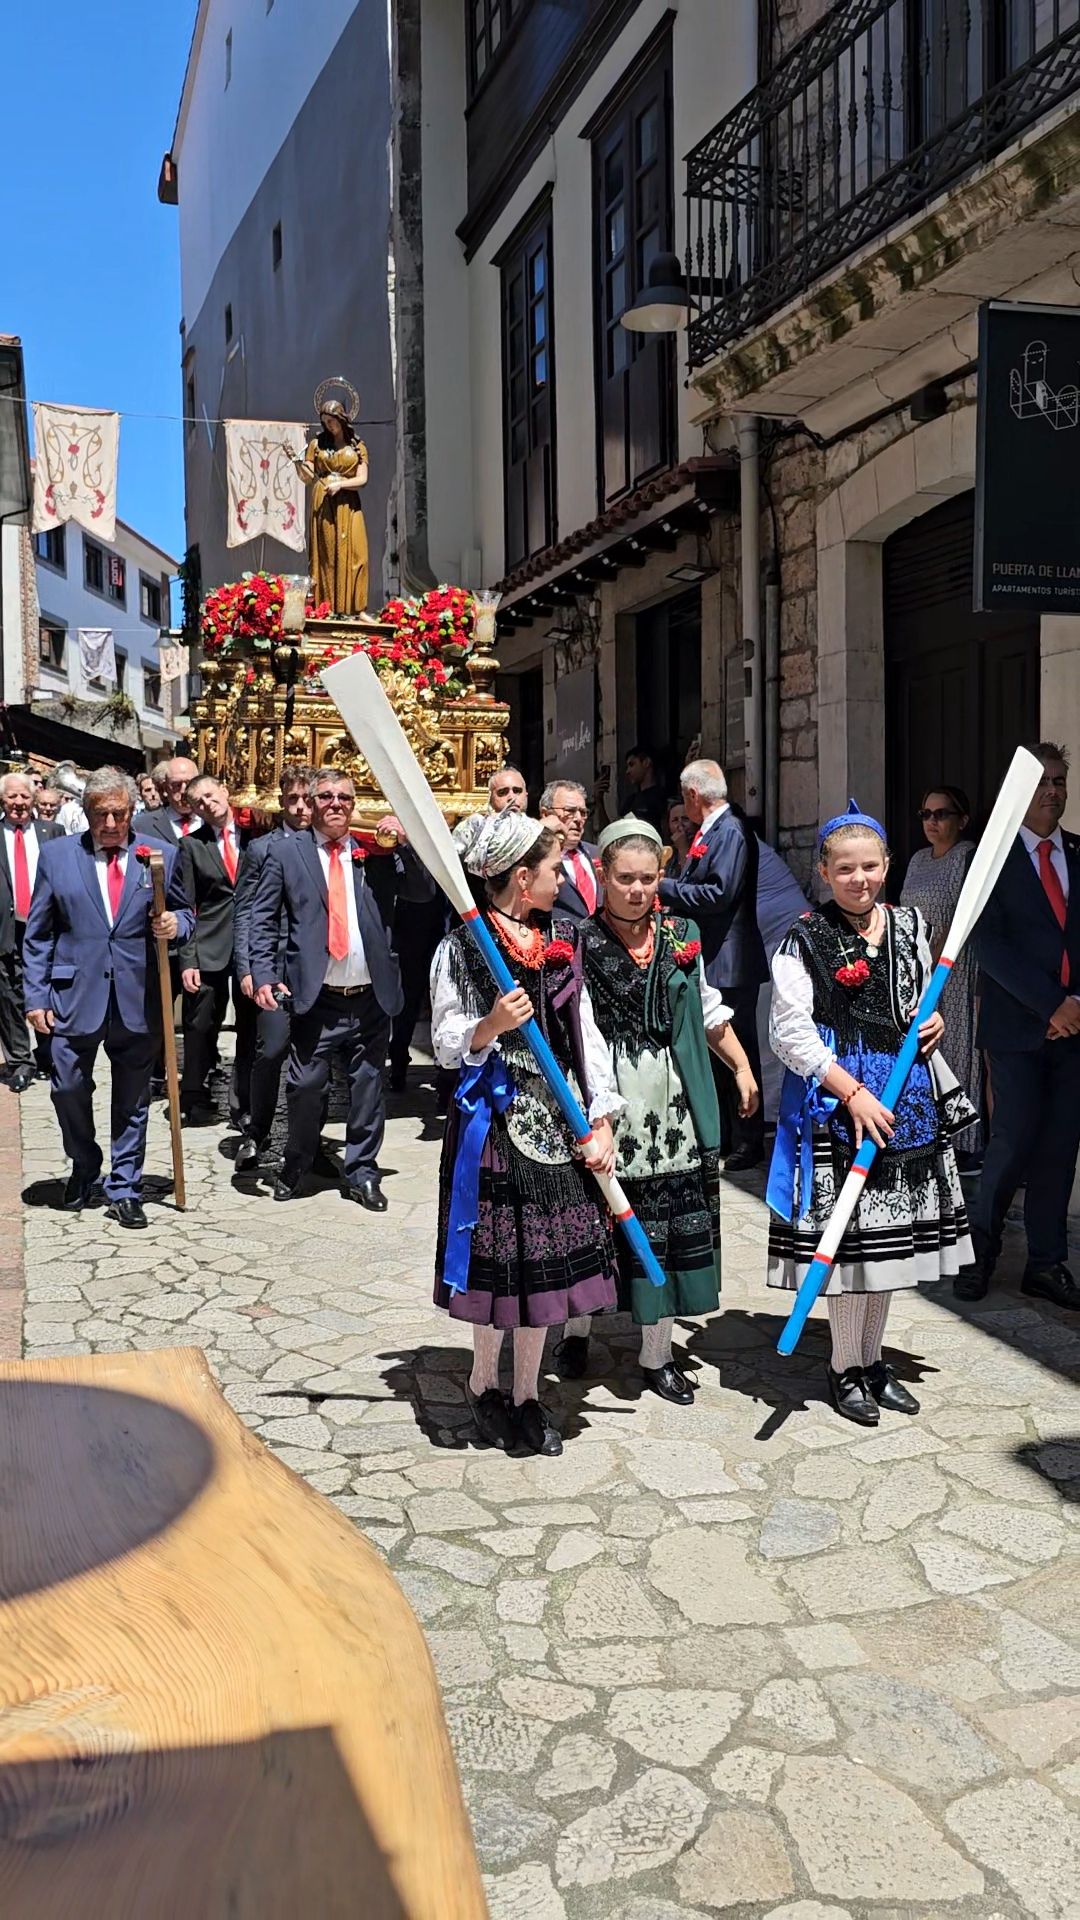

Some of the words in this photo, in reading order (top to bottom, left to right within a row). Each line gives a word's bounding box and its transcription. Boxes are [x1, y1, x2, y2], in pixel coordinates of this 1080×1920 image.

[992, 562, 1035, 576] PUERTA
[1039, 564, 1054, 577] DE
[992, 584, 1052, 595] APARTAMENTOS
